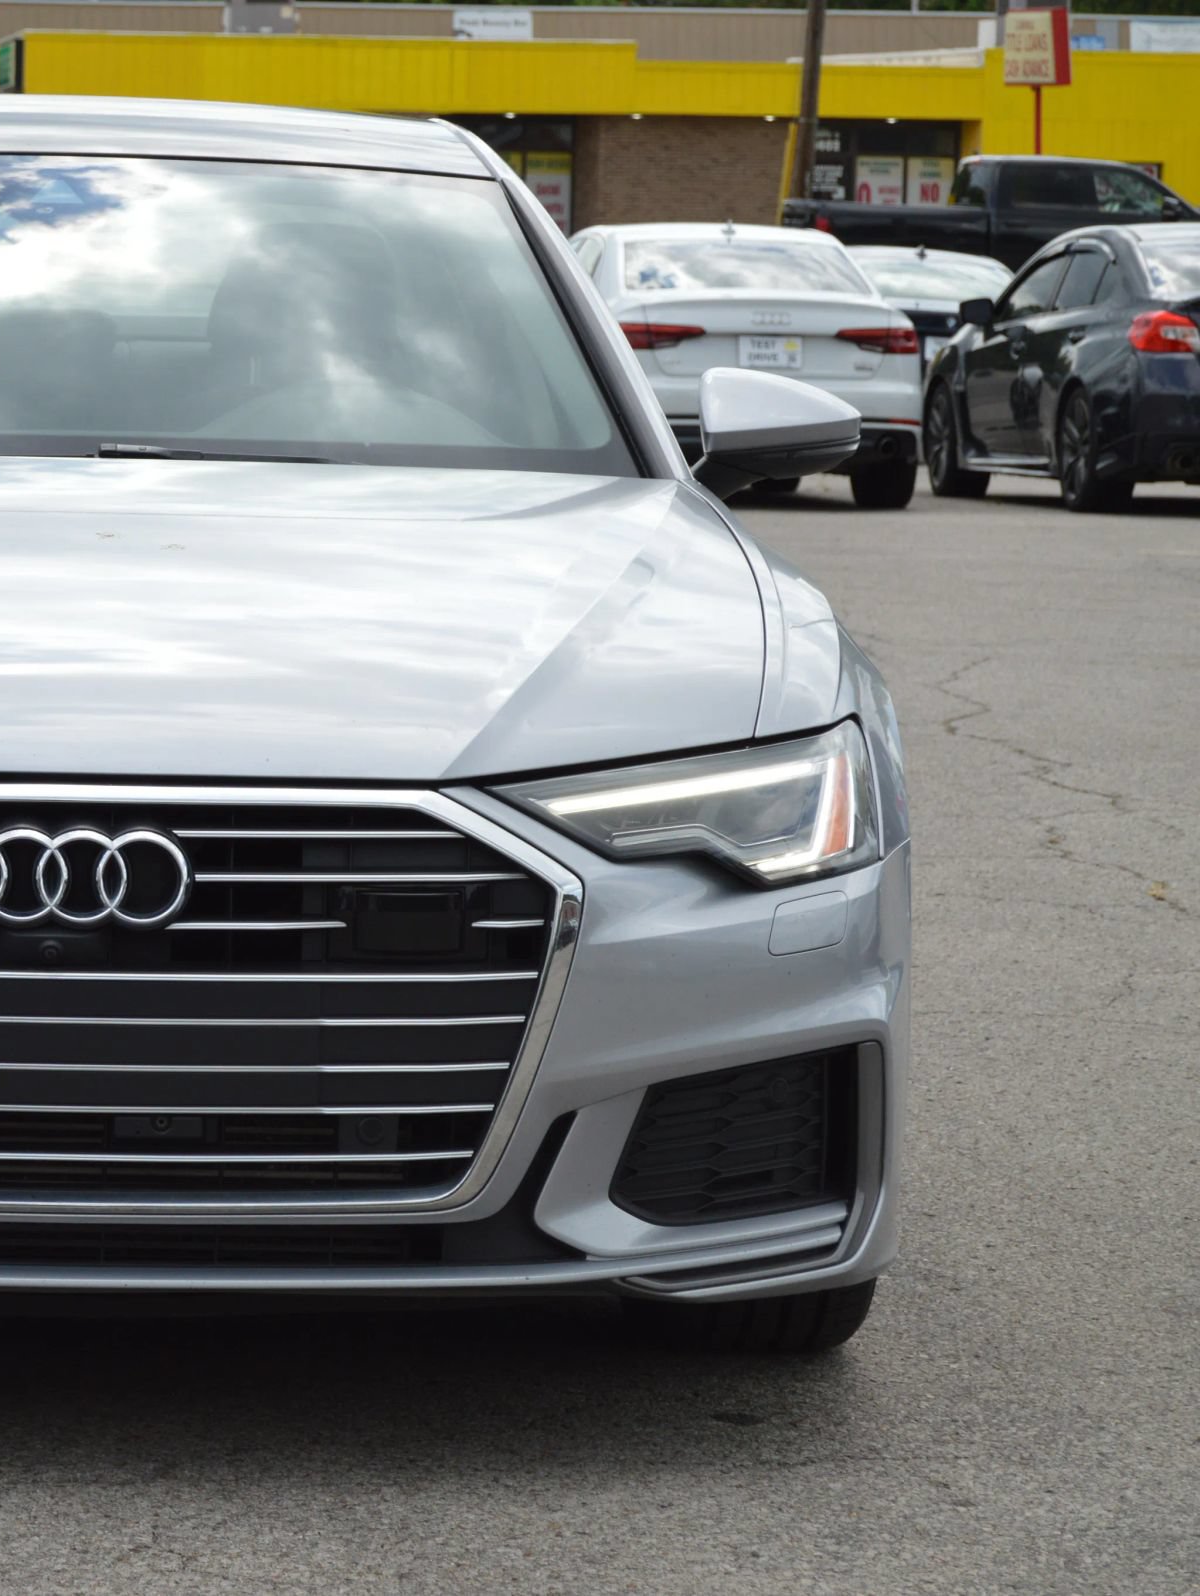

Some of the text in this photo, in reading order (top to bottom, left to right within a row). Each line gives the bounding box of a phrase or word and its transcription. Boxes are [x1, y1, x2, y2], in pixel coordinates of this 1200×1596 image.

[1024, 33, 1048, 53] LOANS
[1022, 59, 1050, 78] ADVANCE
[920, 182, 940, 203] NO
[750, 339, 776, 349] TEST
[747, 352, 779, 362] DRIVE
